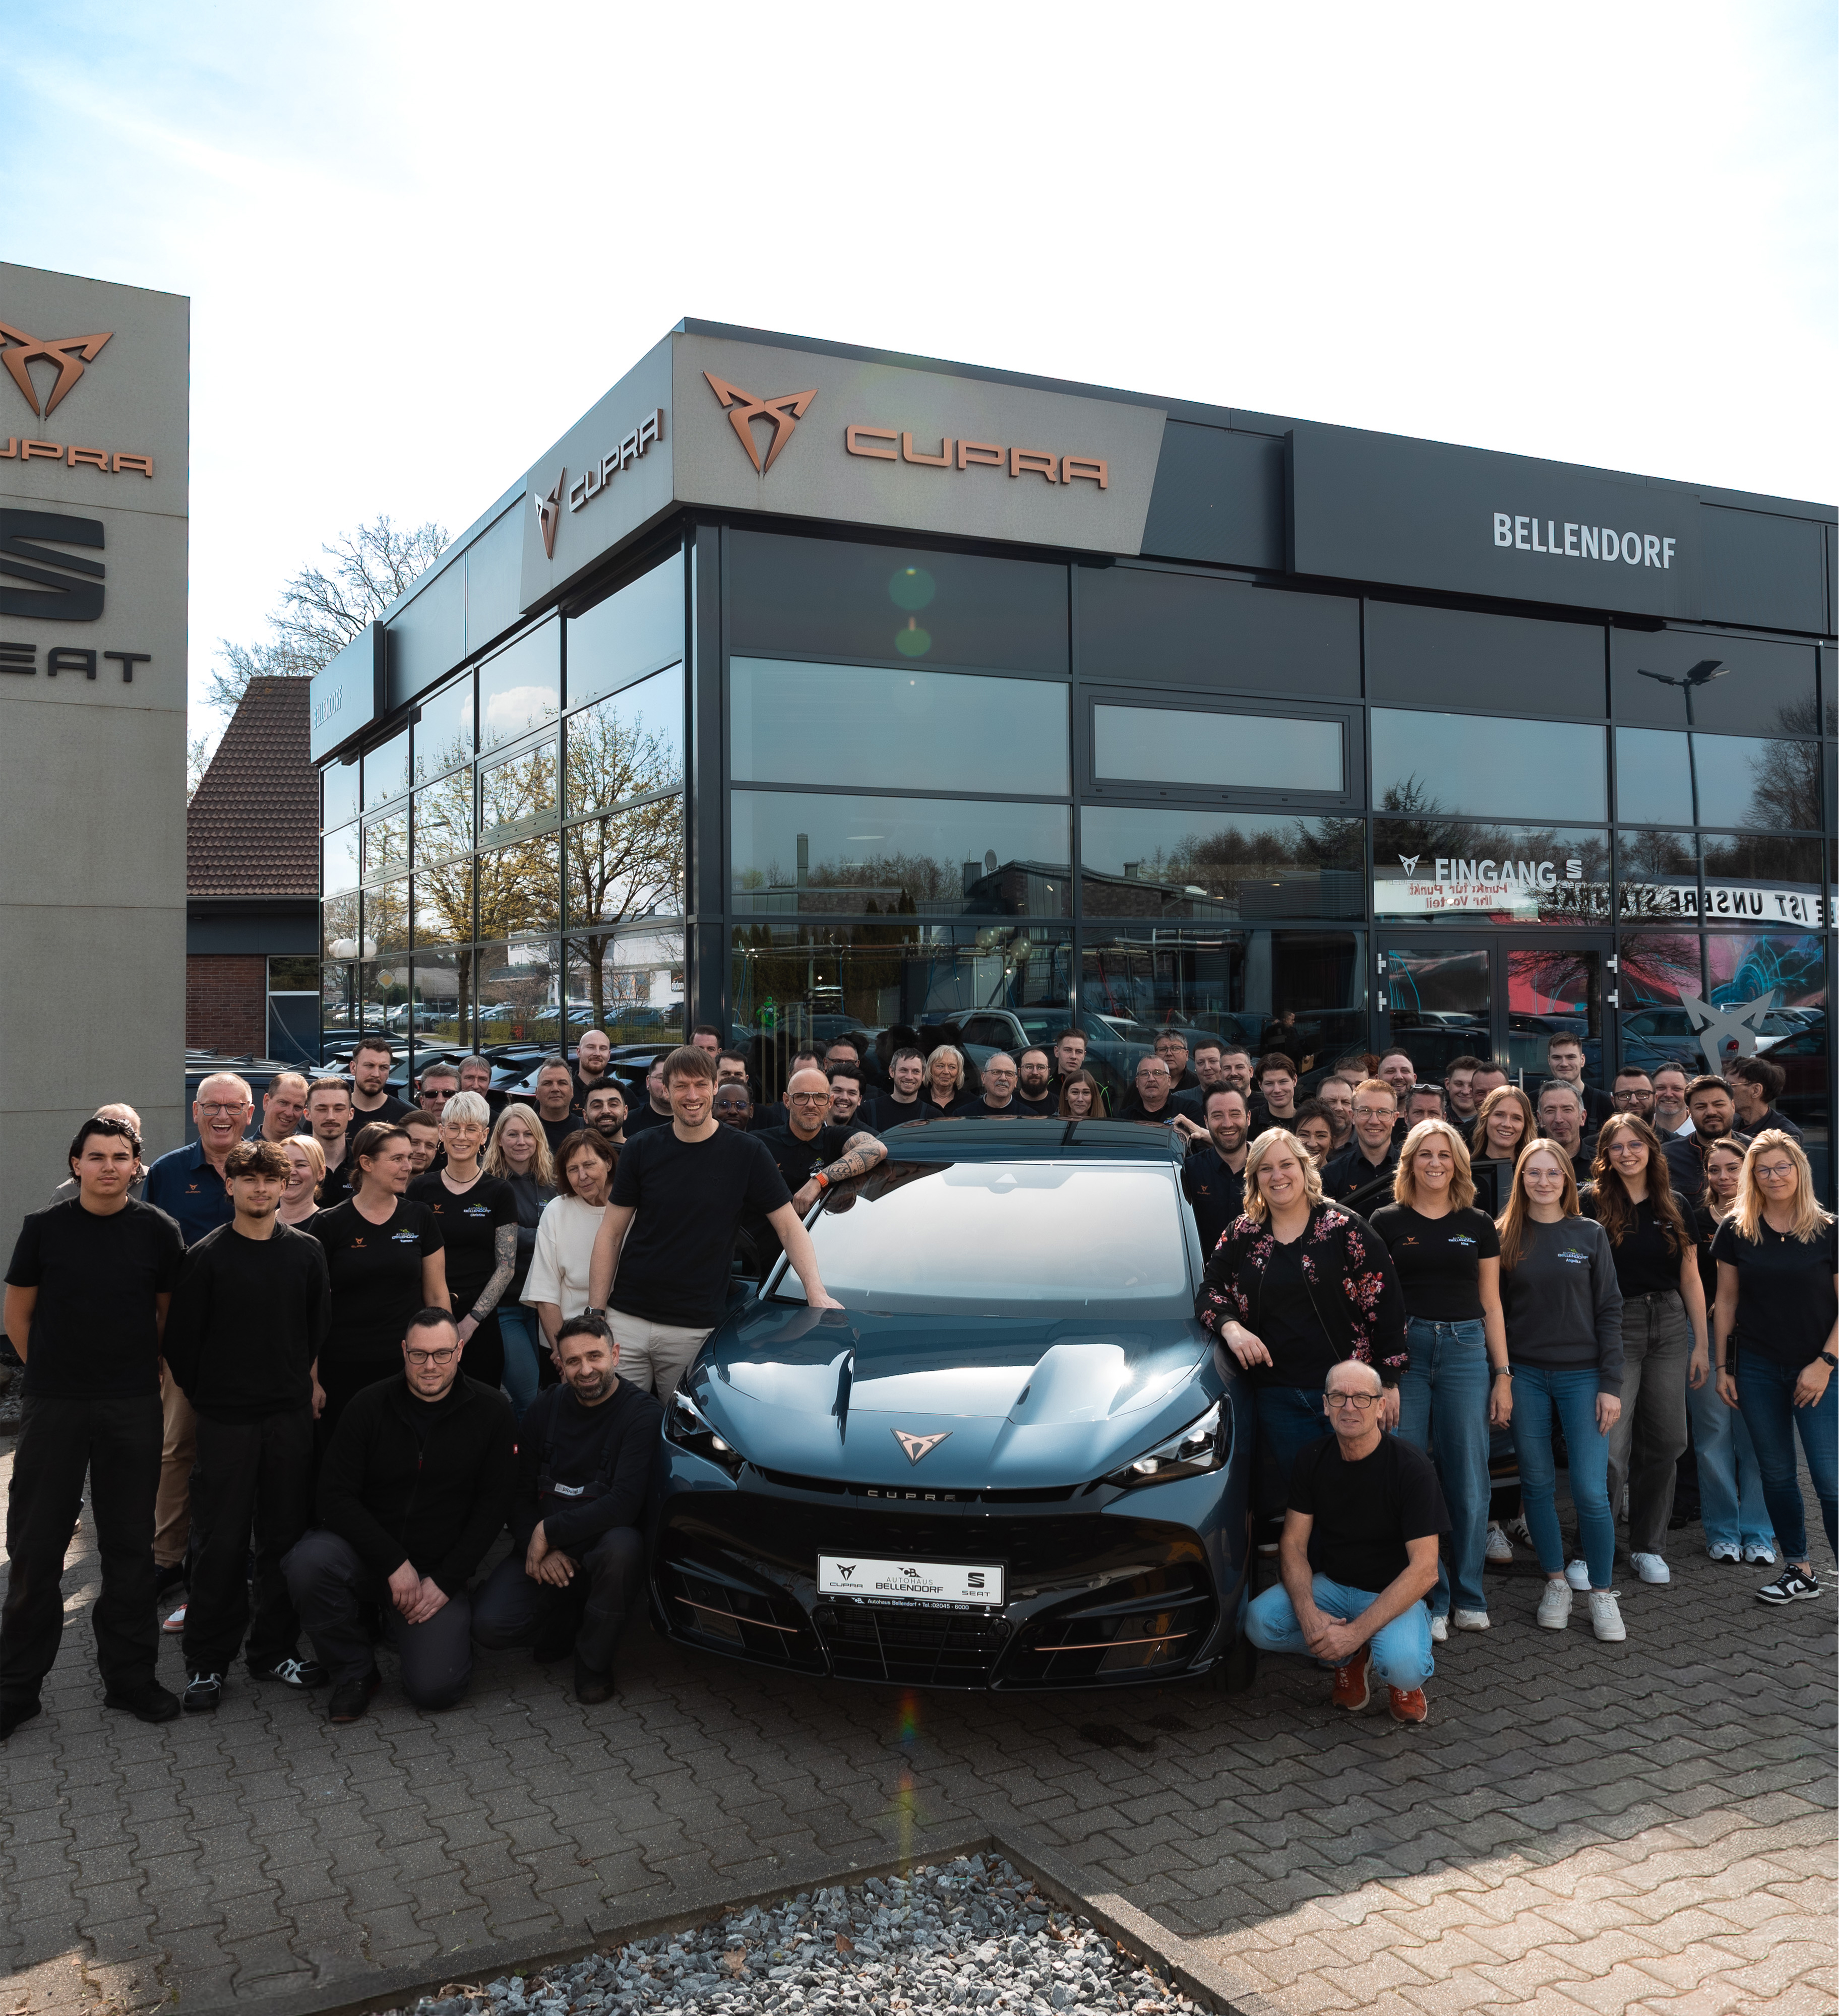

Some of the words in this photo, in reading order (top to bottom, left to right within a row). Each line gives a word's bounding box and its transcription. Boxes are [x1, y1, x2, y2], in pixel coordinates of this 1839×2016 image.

[569, 408, 663, 513] CUPRA
[846, 425, 1108, 489] CUPRA
[1494, 512, 1676, 569] BELLENDORF
[0, 642, 151, 682] EAT
[313, 685, 343, 730] BELLENDORF
[1435, 858, 1556, 889] EINGANG
[868, 1490, 956, 1502] CUPRA
[876, 1582, 944, 1593] BELLENDORF
[886, 1577, 933, 1586] AUTOHAUS
